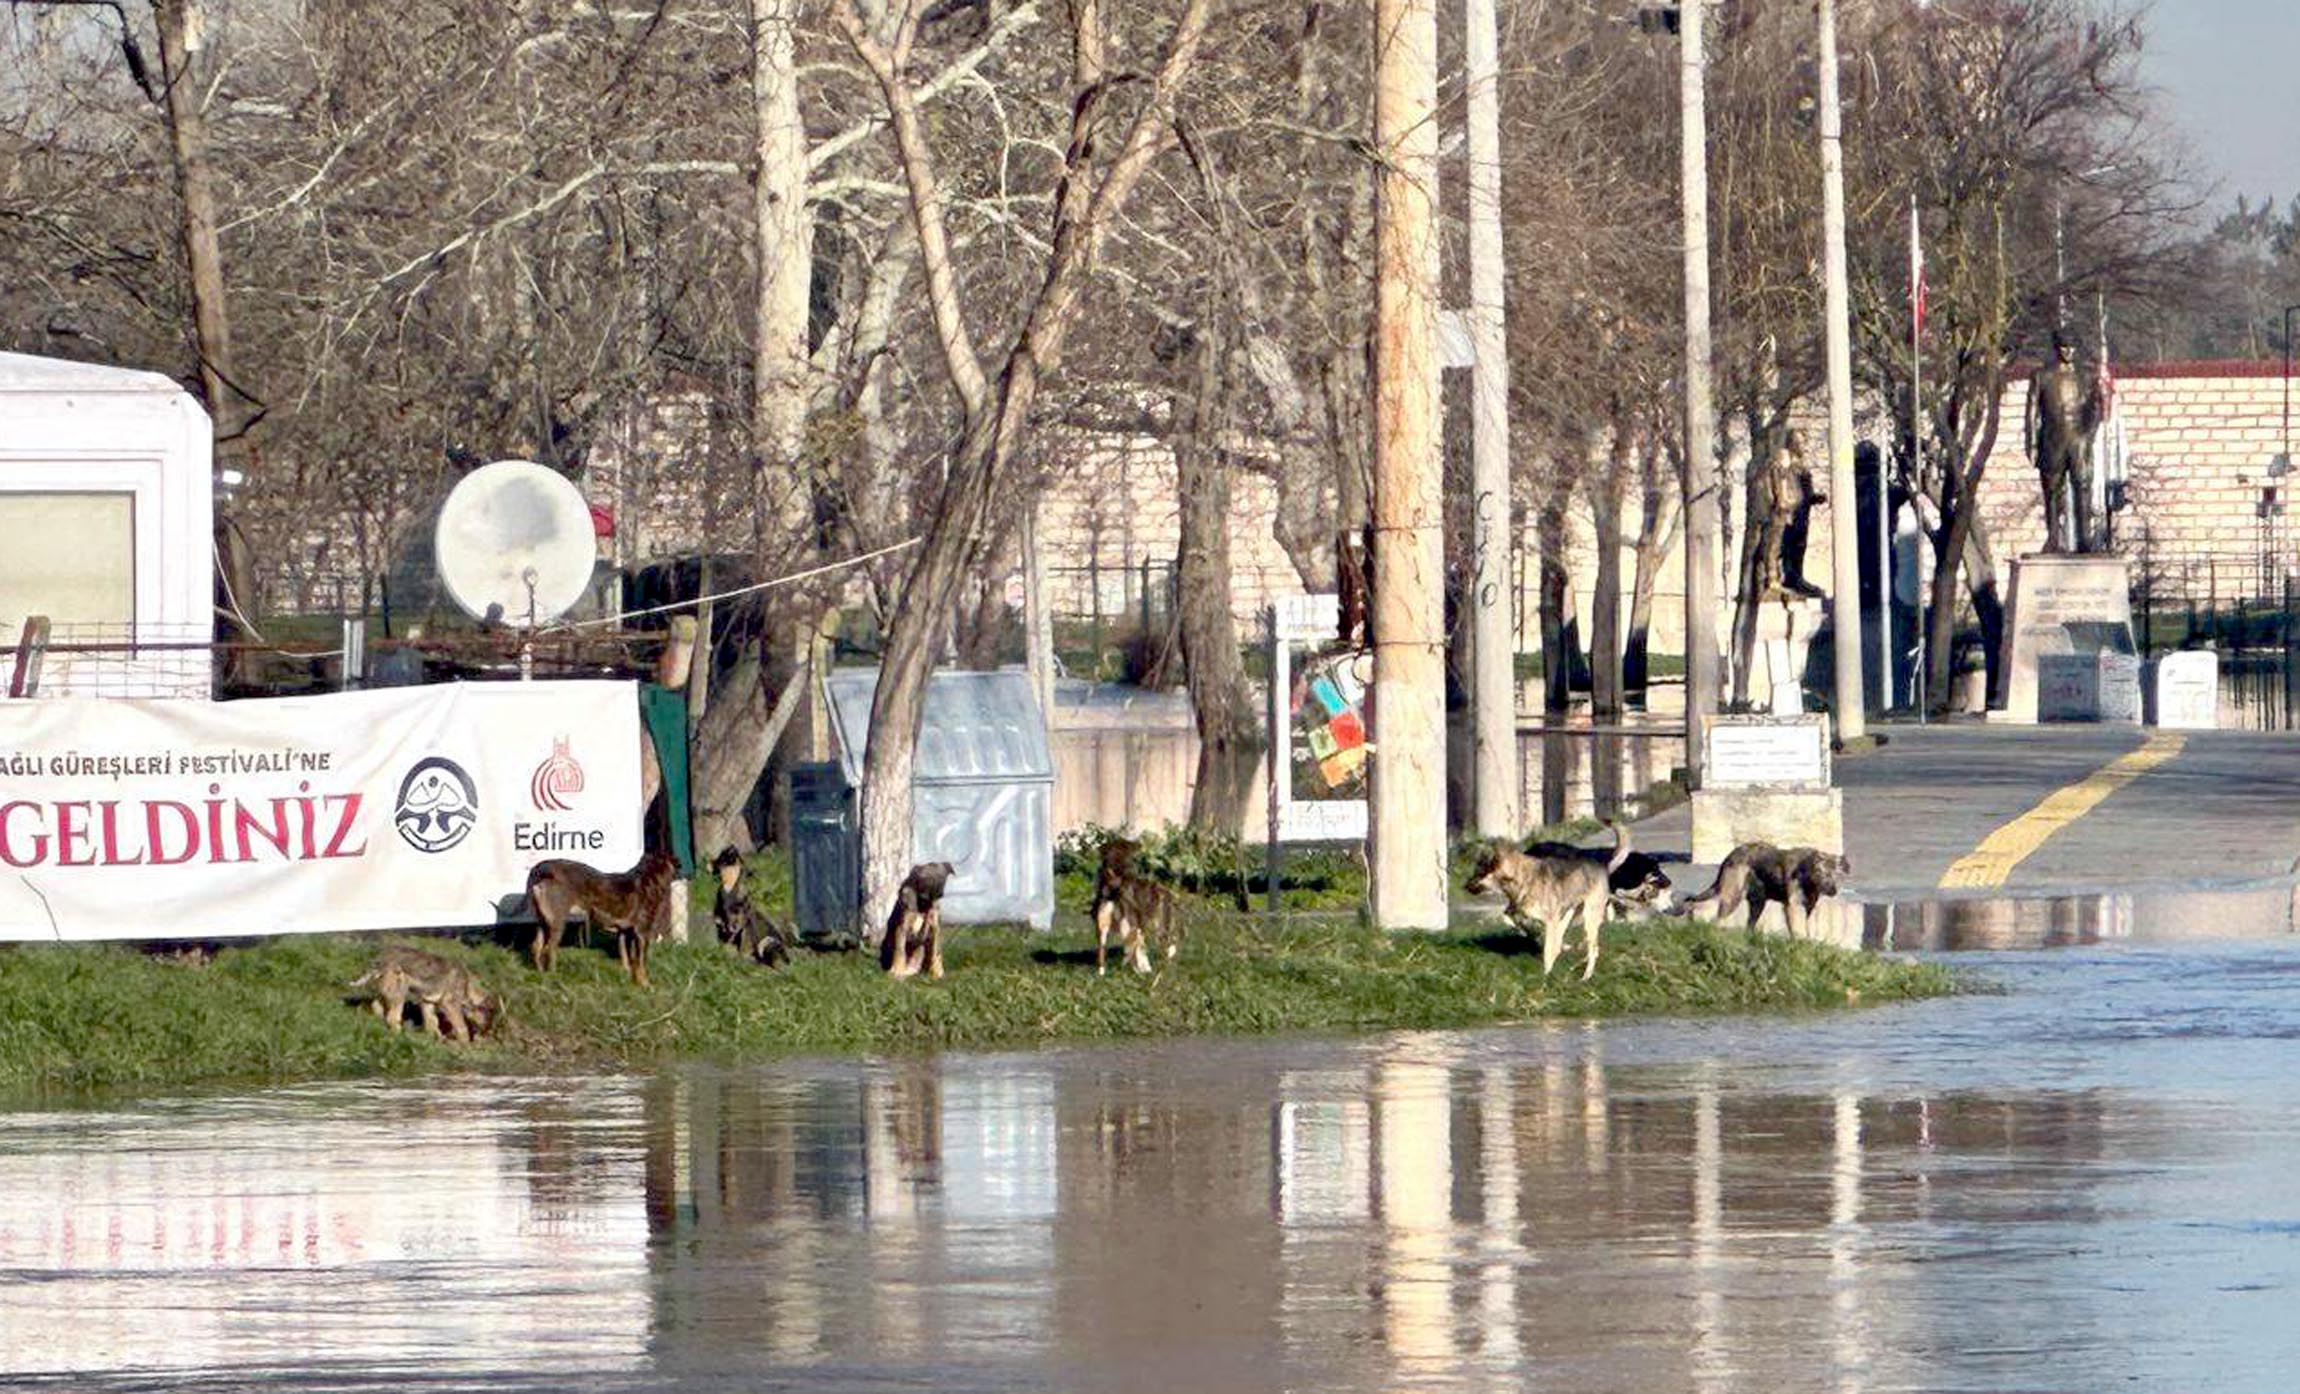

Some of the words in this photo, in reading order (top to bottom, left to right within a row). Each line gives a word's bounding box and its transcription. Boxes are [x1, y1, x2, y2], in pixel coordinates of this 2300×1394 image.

[50, 750, 171, 781] GÜREŞLERİ
[0, 780, 368, 867] GELDİNİZ
[514, 822, 604, 851] Edirne
